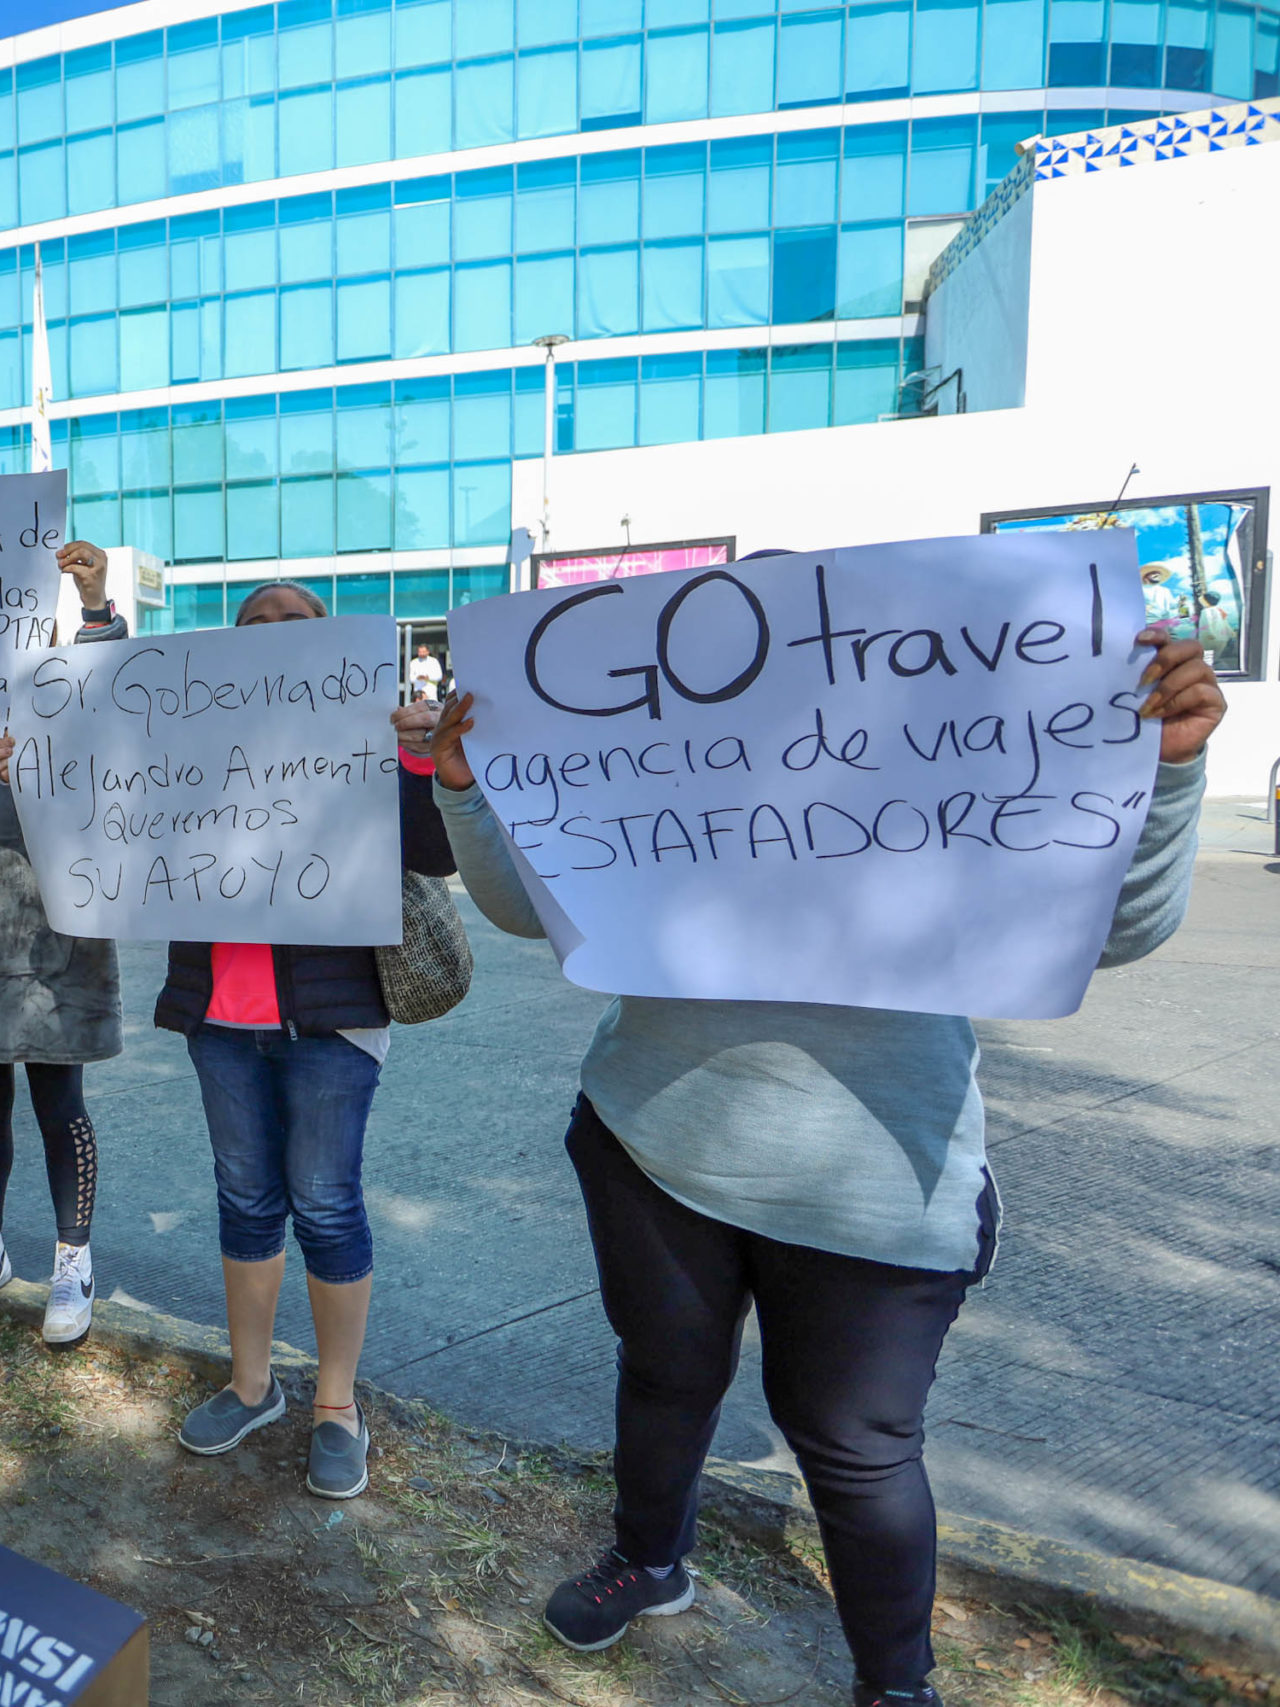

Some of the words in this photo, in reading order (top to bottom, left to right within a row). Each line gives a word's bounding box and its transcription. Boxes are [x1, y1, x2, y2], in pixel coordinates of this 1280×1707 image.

[20, 501, 59, 549] de
[524, 569, 769, 720] GO
[787, 562, 1103, 686] travel
[31, 657, 96, 718] Sr.
[112, 648, 394, 737] Gobernador
[16, 735, 204, 831] Alejandro
[223, 739, 400, 791] Armenta
[485, 736, 751, 826] agencia
[782, 708, 880, 772] de
[904, 690, 1141, 800] viajes
[103, 799, 298, 844] Queremos
[69, 857, 121, 907] SU
[143, 851, 330, 905] APOYO
